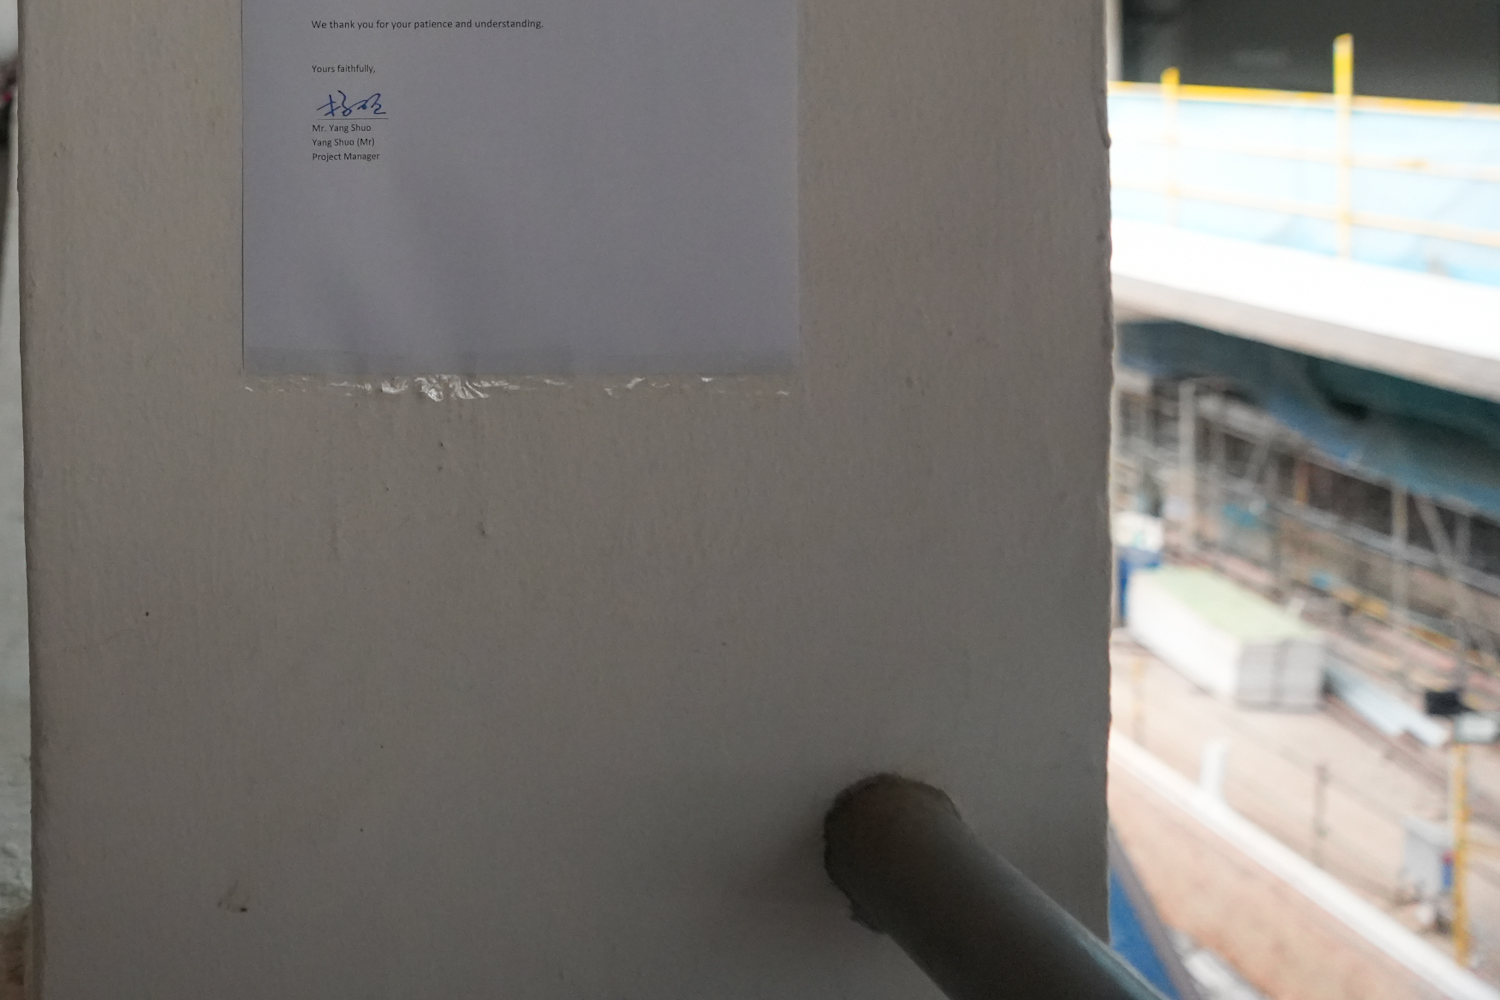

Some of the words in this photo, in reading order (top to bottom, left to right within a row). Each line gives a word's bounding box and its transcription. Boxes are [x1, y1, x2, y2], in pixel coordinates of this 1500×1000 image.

[310, 19, 328, 30] We
[328, 19, 356, 30] thank
[356, 21, 375, 31] you
[375, 18, 390, 29] for
[390, 21, 413, 31] your
[413, 19, 454, 31] patience
[454, 18, 473, 29] and
[474, 18, 545, 30] understanding.
[311, 64, 336, 74] Yours
[337, 63, 376, 75] faithfully,
[311, 123, 327, 133] Mr.
[328, 124, 350, 134] Yang
[350, 123, 372, 133] Shuo
[311, 138, 333, 149] Yang
[333, 138, 355, 147] Shuo
[356, 137, 375, 148] (Mr)
[311, 152, 342, 163] Project
[343, 152, 381, 163] Manager
